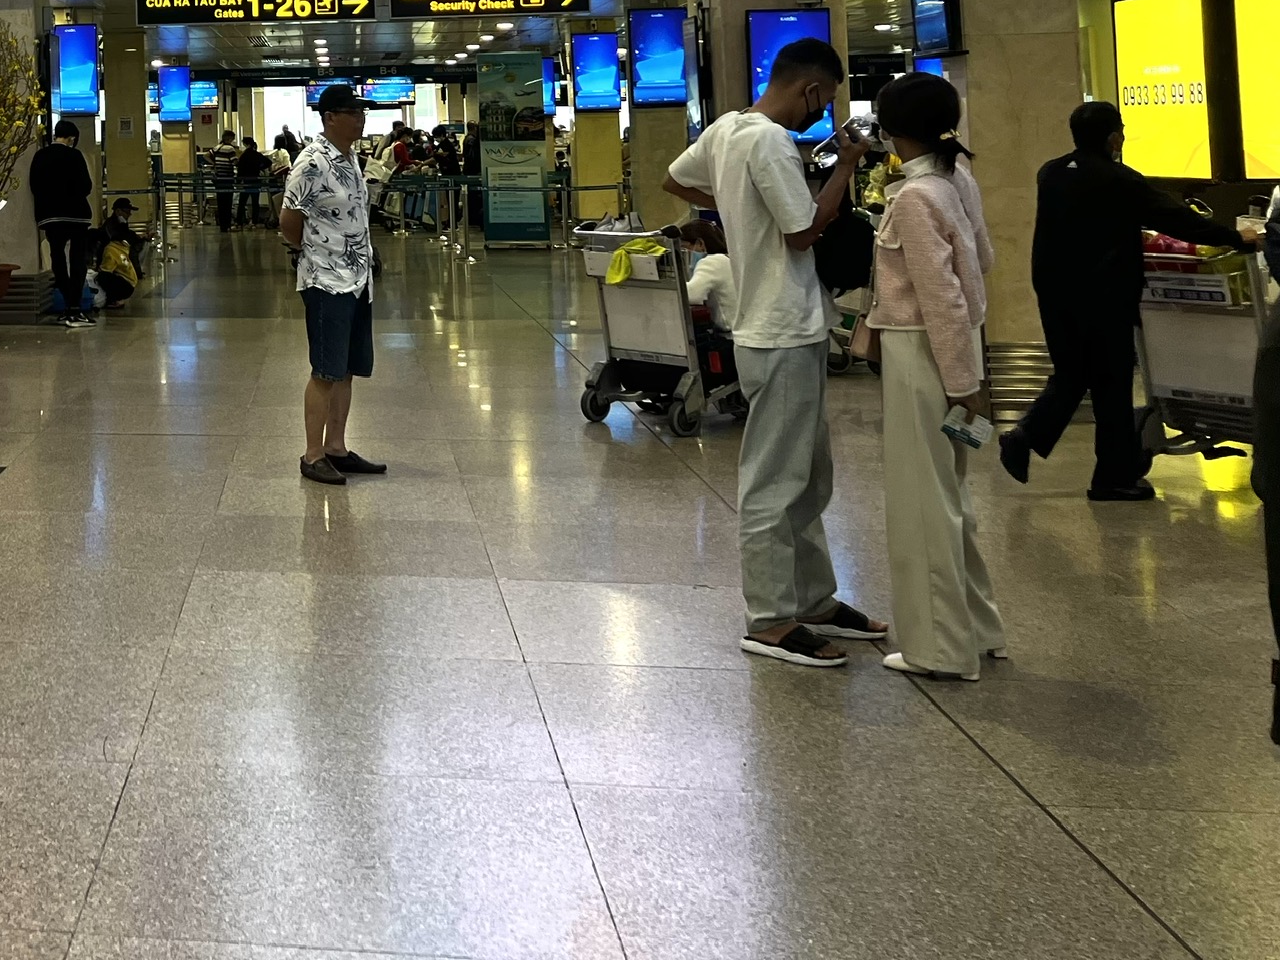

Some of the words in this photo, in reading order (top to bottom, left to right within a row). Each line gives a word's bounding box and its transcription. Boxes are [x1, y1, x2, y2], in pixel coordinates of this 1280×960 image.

[429, 0, 476, 12] Security
[214, 9, 244, 18] Gates
[317, 67, 335, 76] B-5
[380, 67, 397, 75] B-6
[1123, 85, 1149, 106] 0933
[1153, 84, 1166, 105] 33
[1171, 83, 1184, 104] 99
[1189, 82, 1204, 104] 88
